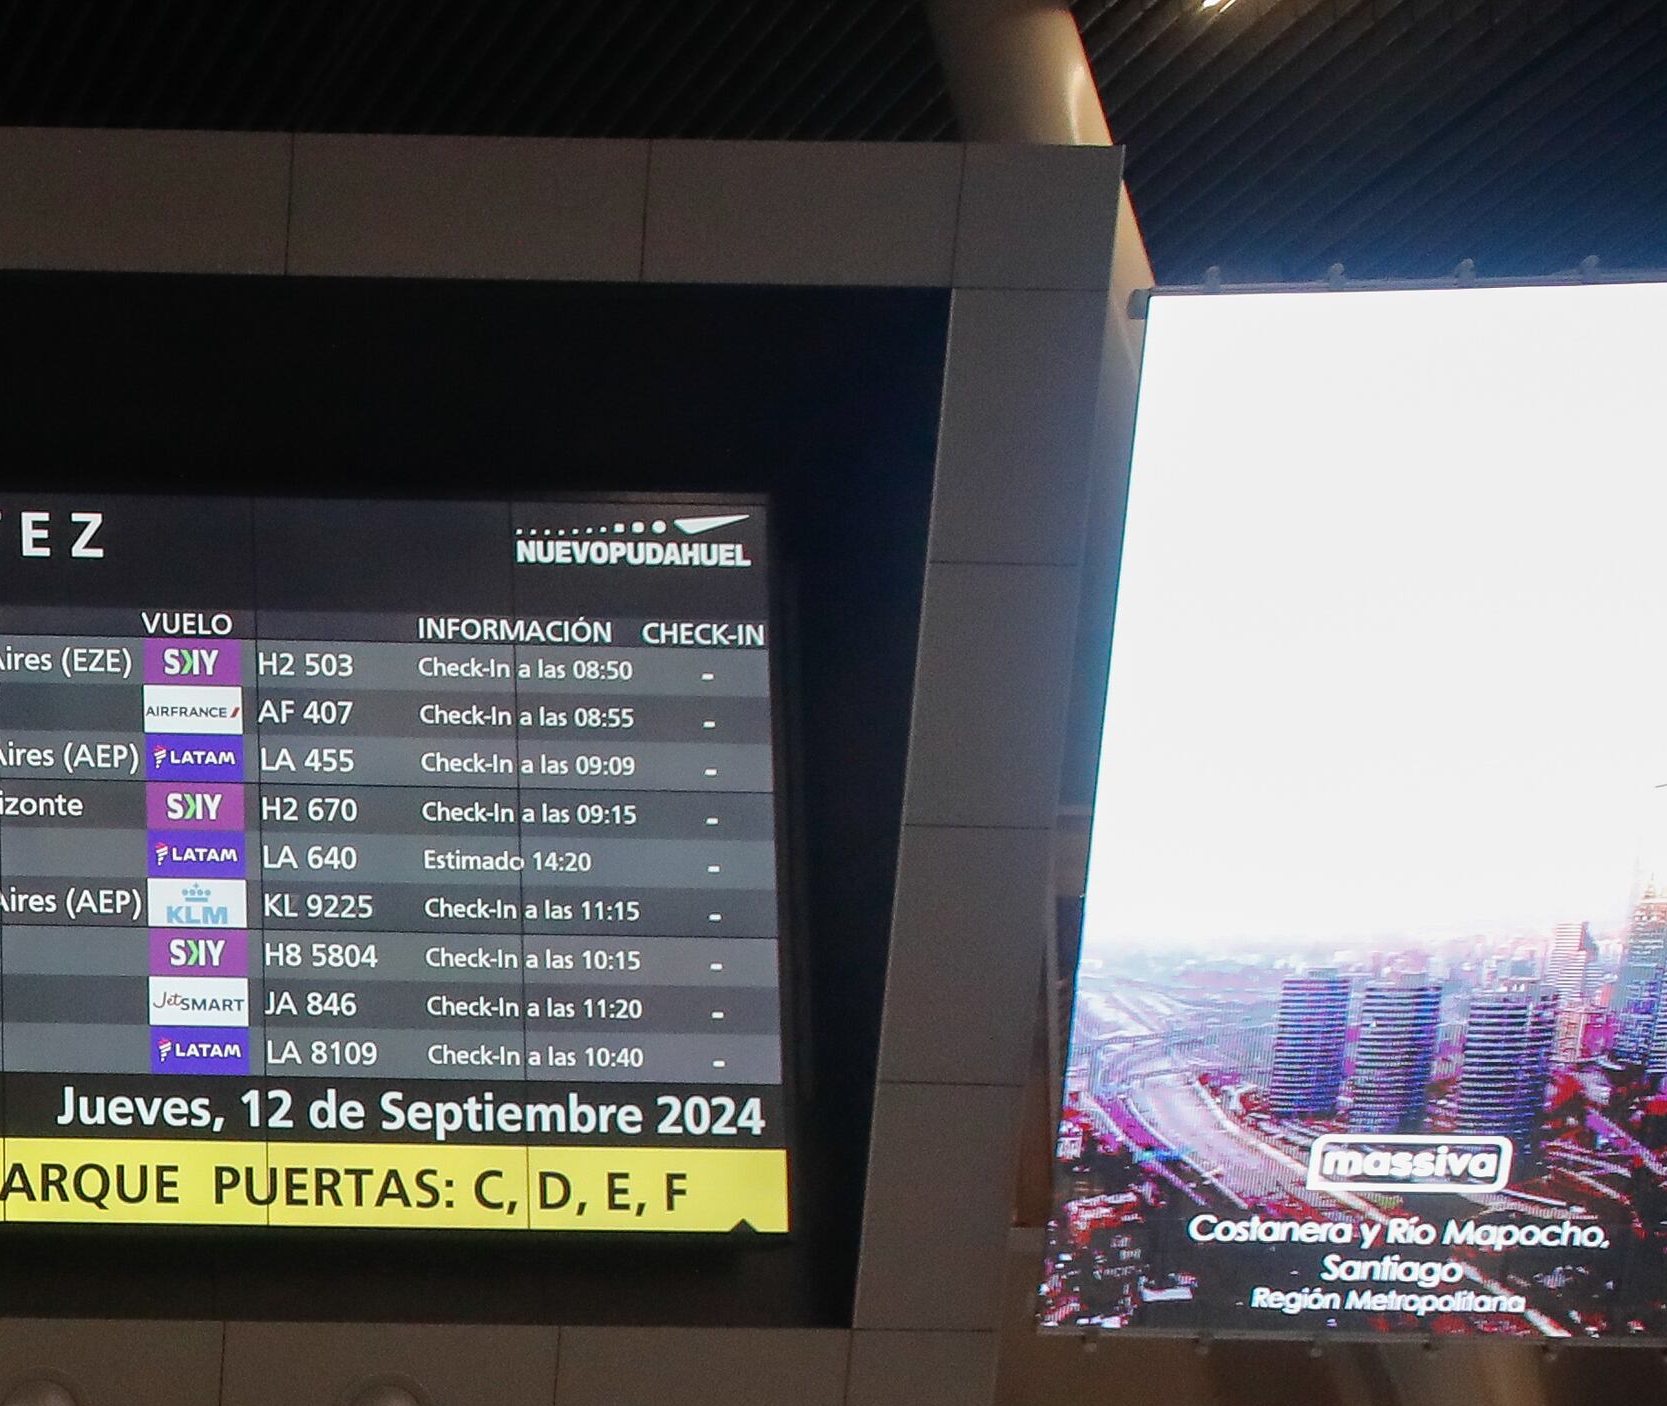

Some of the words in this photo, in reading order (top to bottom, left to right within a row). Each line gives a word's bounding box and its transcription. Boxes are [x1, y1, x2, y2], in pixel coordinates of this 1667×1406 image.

[516, 539, 752, 567] NUEVOPUDAHUEL
[172, 847, 238, 862] LATAM
[263, 844, 299, 869] LA
[307, 845, 357, 870] 640
[423, 849, 525, 871] Estimado
[532, 851, 592, 872] 14:20
[57, 1086, 226, 1134] Jueves,
[241, 1089, 294, 1128] 12
[309, 1088, 365, 1130] de
[380, 1091, 643, 1141] Septiembre
[657, 1095, 766, 1135] 2024
[1322, 1145, 1498, 1178] massiva
[213, 1164, 456, 1210] PUERTAS:
[474, 1170, 517, 1215] C,
[539, 1171, 586, 1216] D,
[607, 1172, 645, 1216] E,
[666, 1173, 687, 1211] F
[1188, 1215, 1353, 1246] Costanera
[1358, 1223, 1381, 1250] y
[1387, 1216, 1438, 1246] Río
[1443, 1219, 1611, 1252] Mapocho,
[1321, 1255, 1464, 1287] Santiago
[1252, 1288, 1338, 1314] Región
[1345, 1288, 1526, 1314] Metropolitana
